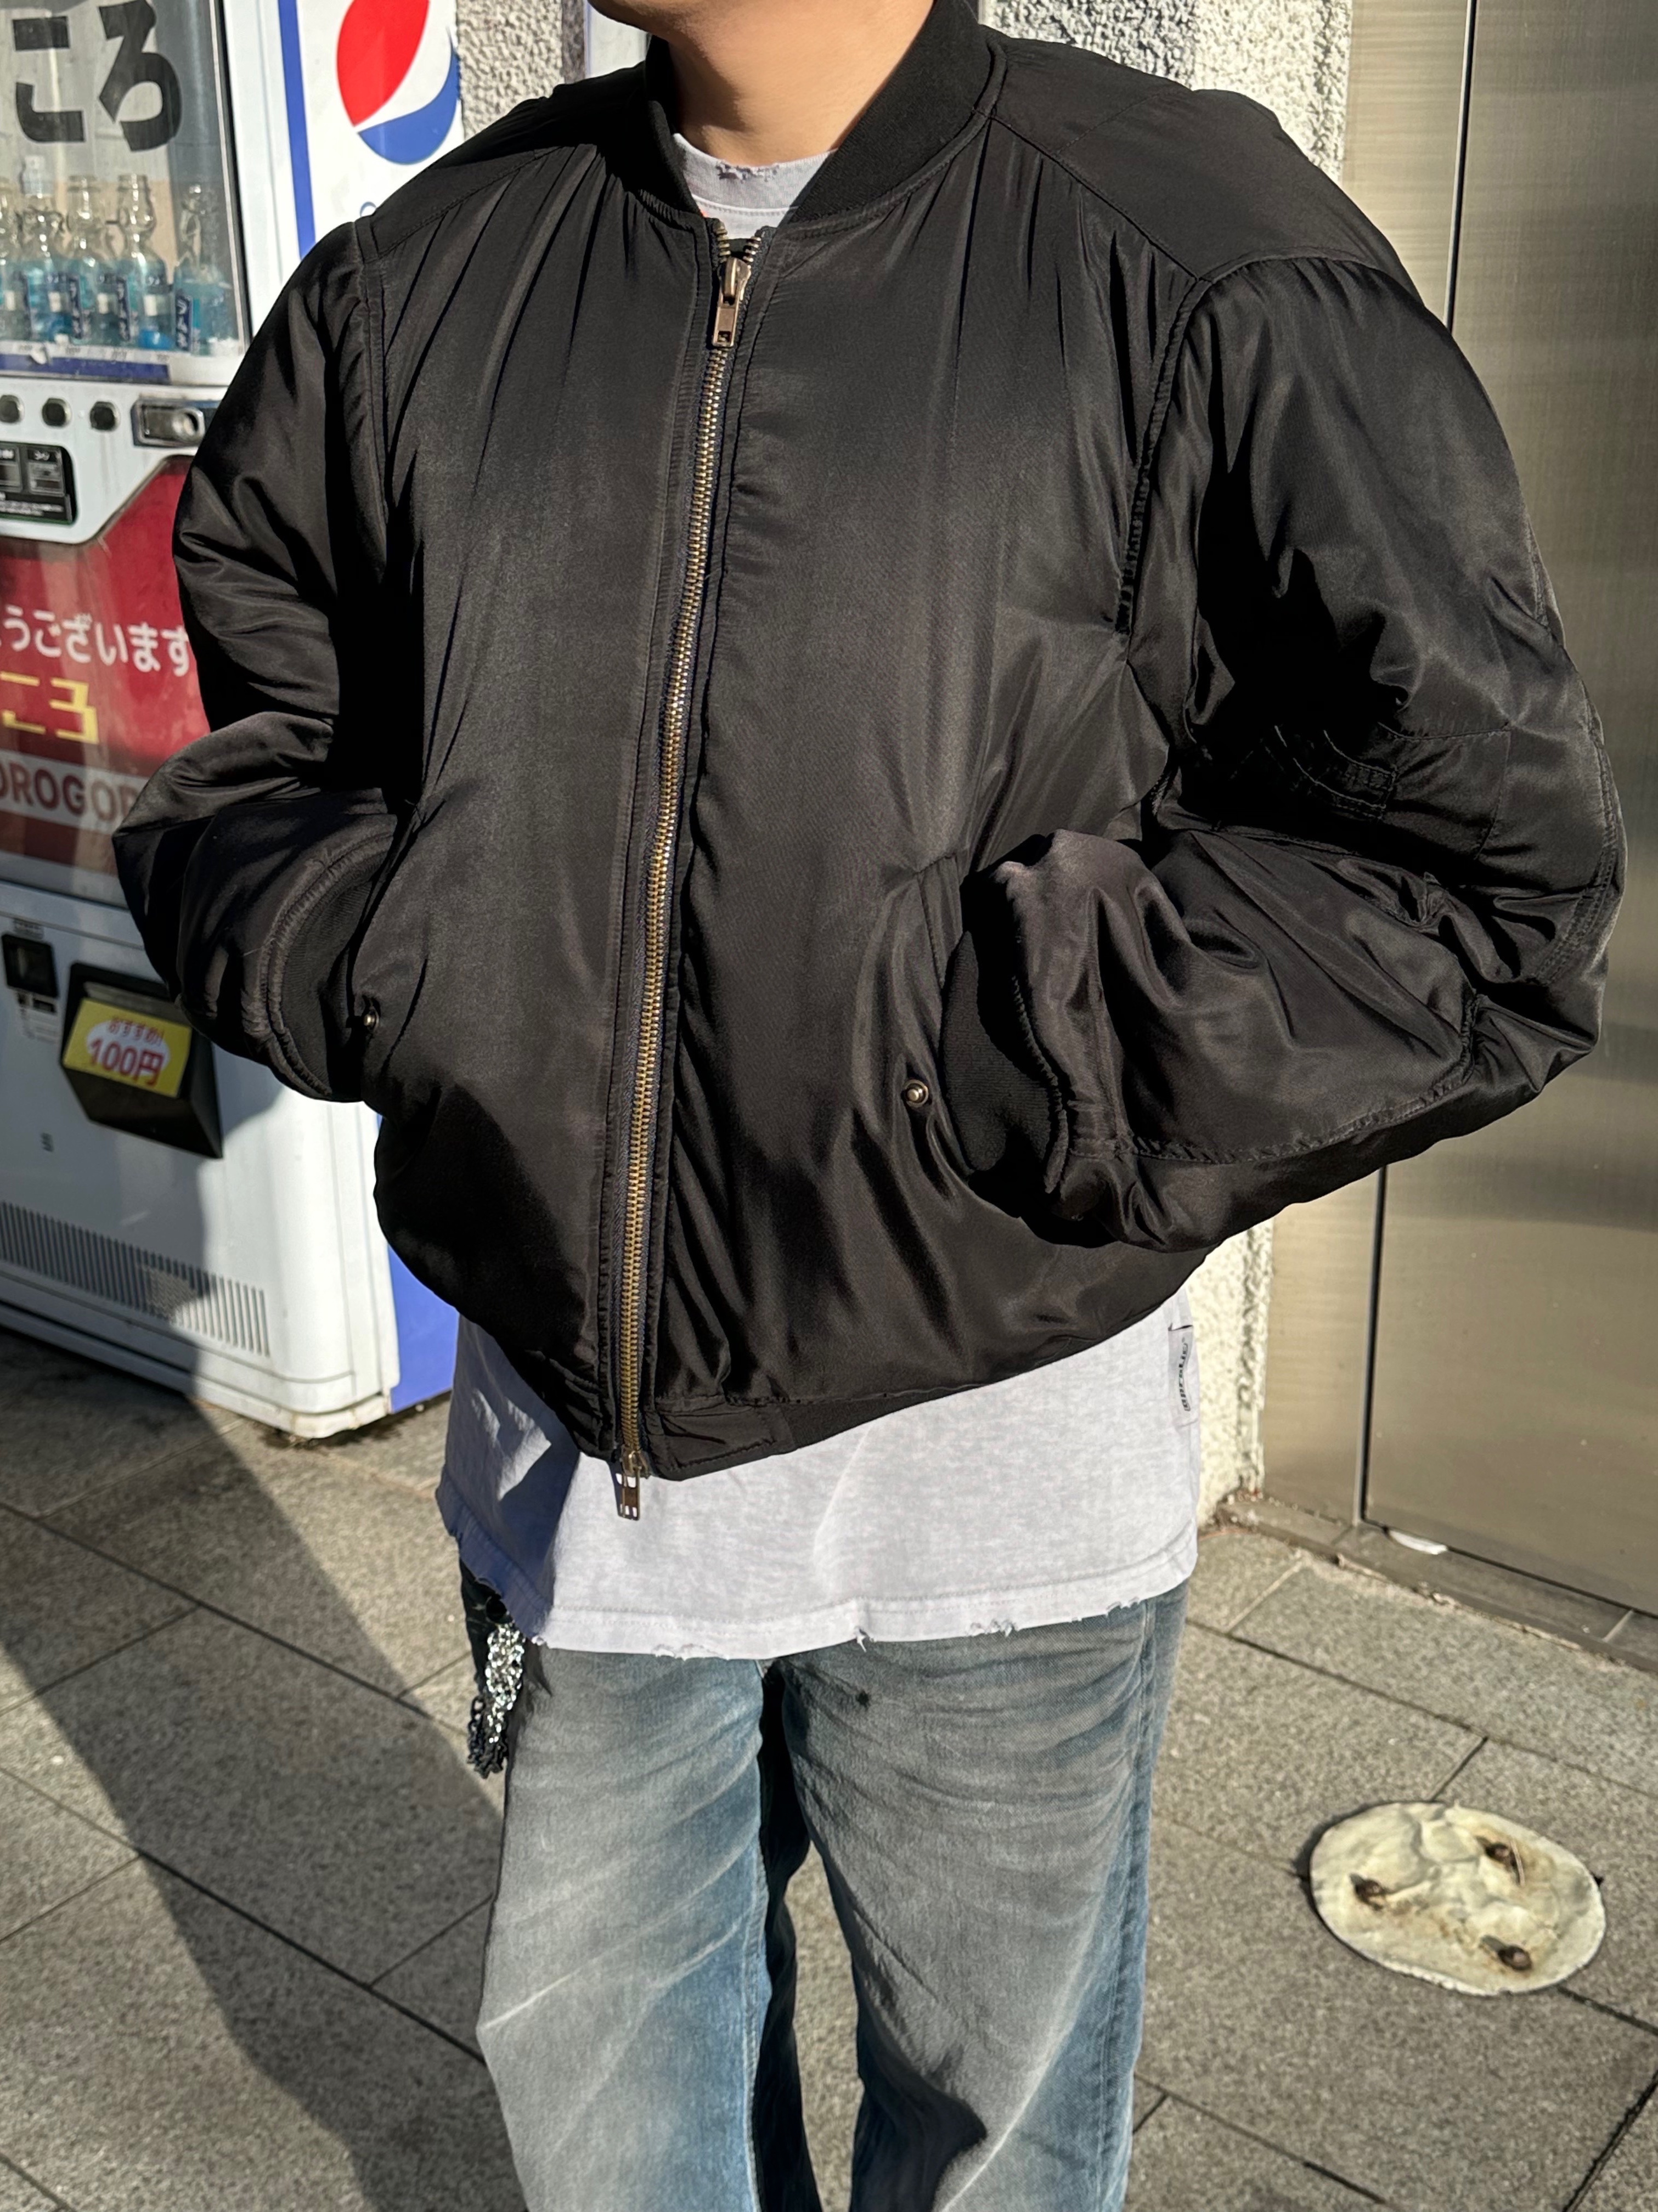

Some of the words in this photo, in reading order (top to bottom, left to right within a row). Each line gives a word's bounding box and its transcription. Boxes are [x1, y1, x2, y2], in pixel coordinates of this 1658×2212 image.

[12, 0, 182, 153] ころ
[4, 605, 190, 676] うございます
[91, 1038, 164, 1086] 100円
